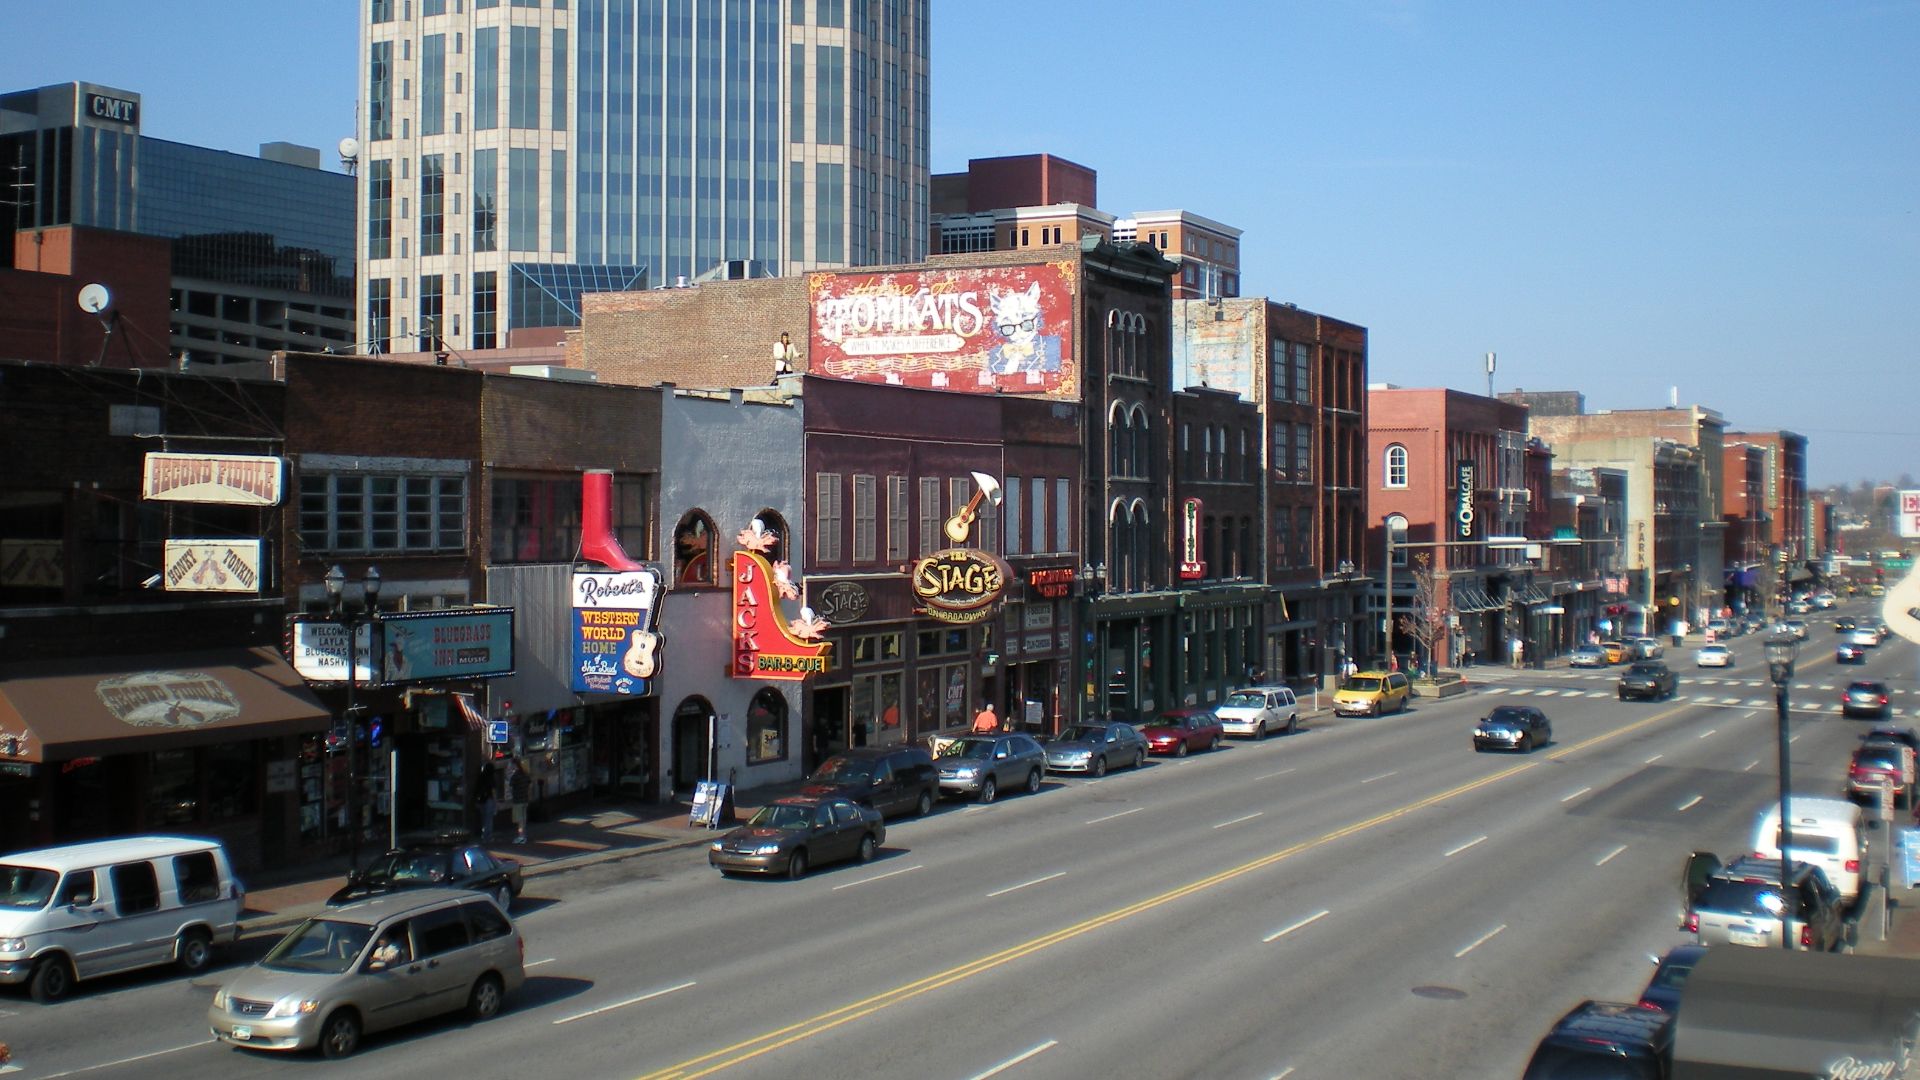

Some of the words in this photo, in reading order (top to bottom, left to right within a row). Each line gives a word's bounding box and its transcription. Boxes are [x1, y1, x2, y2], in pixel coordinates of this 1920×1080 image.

[93, 96, 132, 120] CMT
[823, 288, 983, 342] TOMKATS
[851, 341, 870, 352] WHEN
[152, 458, 212, 495] SECOND
[216, 460, 274, 501] FIDDLE
[949, 551, 967, 561] THE
[168, 548, 197, 586] HONKY
[919, 558, 1000, 597] STAGE
[580, 577, 646, 606] Robert's
[822, 587, 867, 615] STAGE
[581, 611, 640, 625] WESTERN
[737, 563, 759, 673] JACKS
[928, 607, 941, 618] ON
[943, 609, 988, 621] BROADWAY
[311, 627, 349, 636] WELCOME
[433, 624, 491, 643] BLUEGRASS
[581, 626, 626, 640] WORLD
[305, 647, 348, 656] BLUEGRAS
[582, 641, 617, 654] HOME
[318, 658, 360, 667] NASHVIE
[459, 656, 488, 664] MUSIC
[581, 660, 617, 674] Sho-Bud
[758, 657, 823, 671] BAR-B-QUE
[1829, 1048, 1912, 1080] Rippy's
